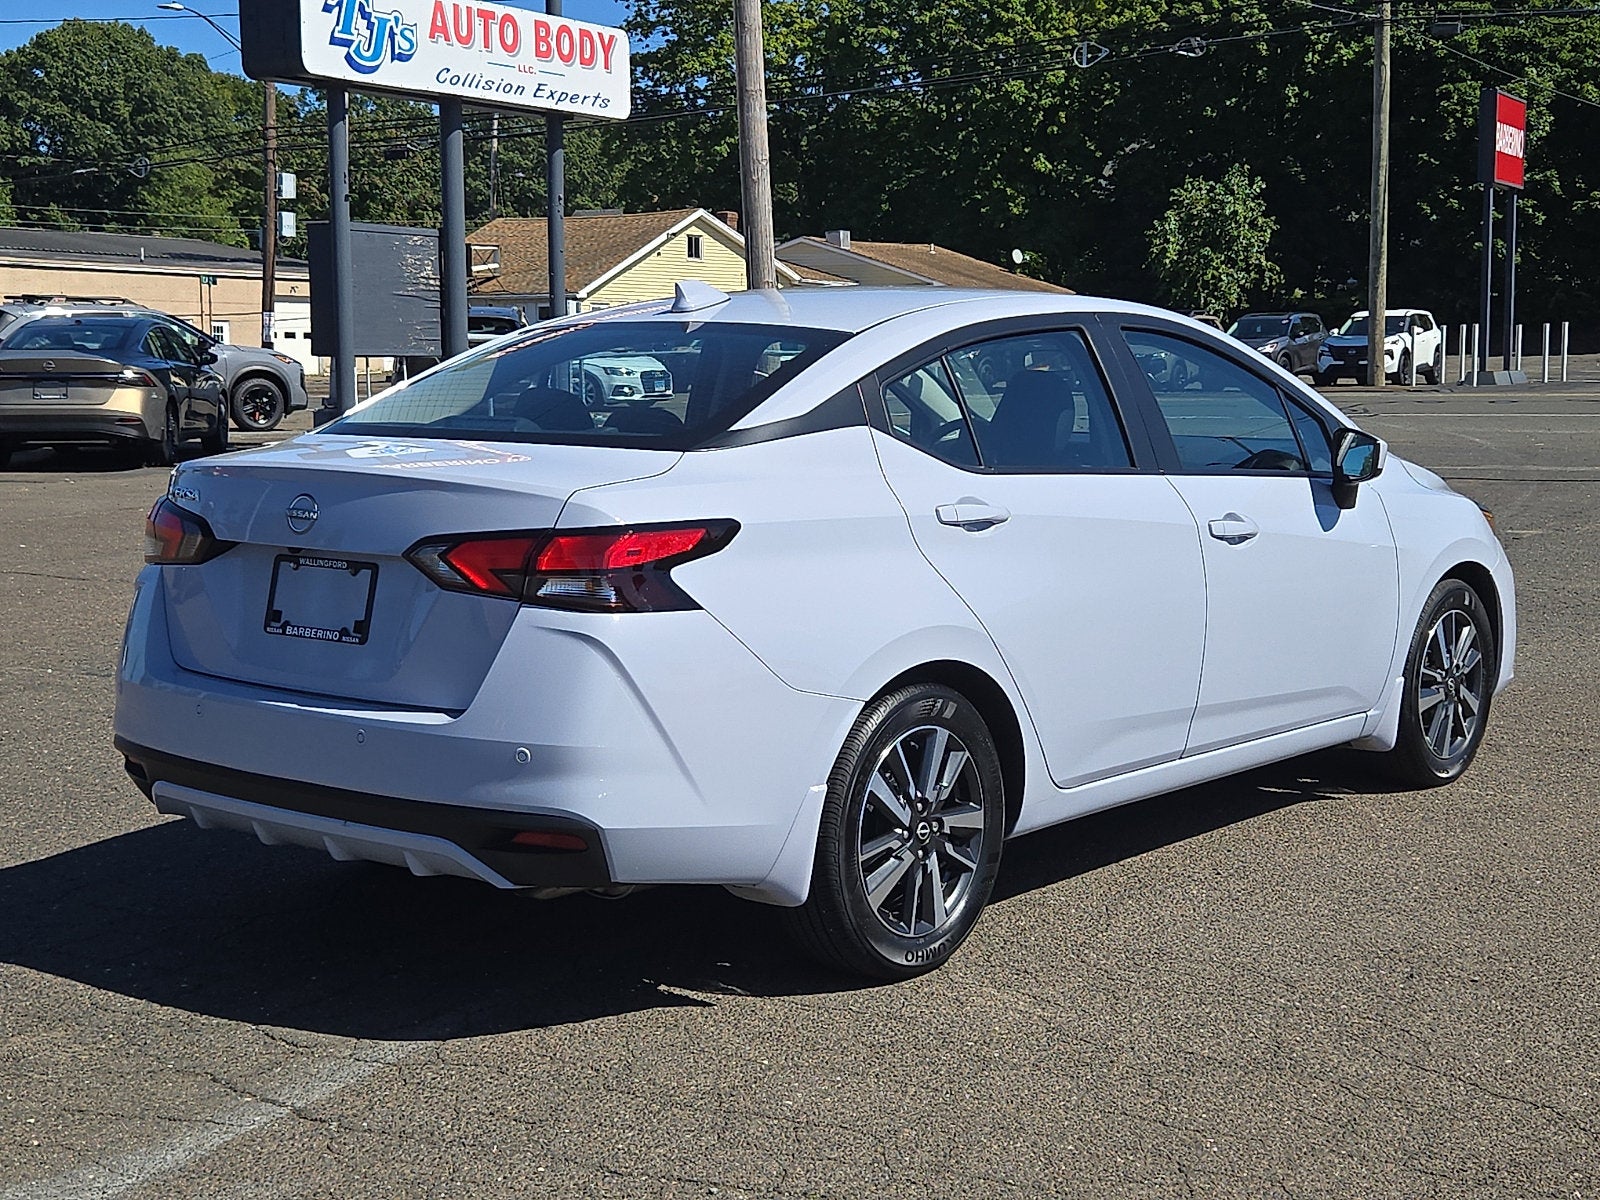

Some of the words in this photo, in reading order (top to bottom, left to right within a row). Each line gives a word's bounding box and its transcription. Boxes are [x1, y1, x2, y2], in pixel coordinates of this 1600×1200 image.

[322, 0, 418, 74] TJ's
[428, 0, 520, 57] AUTO
[534, 19, 617, 72] BODY
[435, 67, 526, 96] Collision
[533, 82, 611, 109] Experts
[299, 557, 348, 570] WALLINGFORD
[286, 625, 340, 641] BARBERINO
